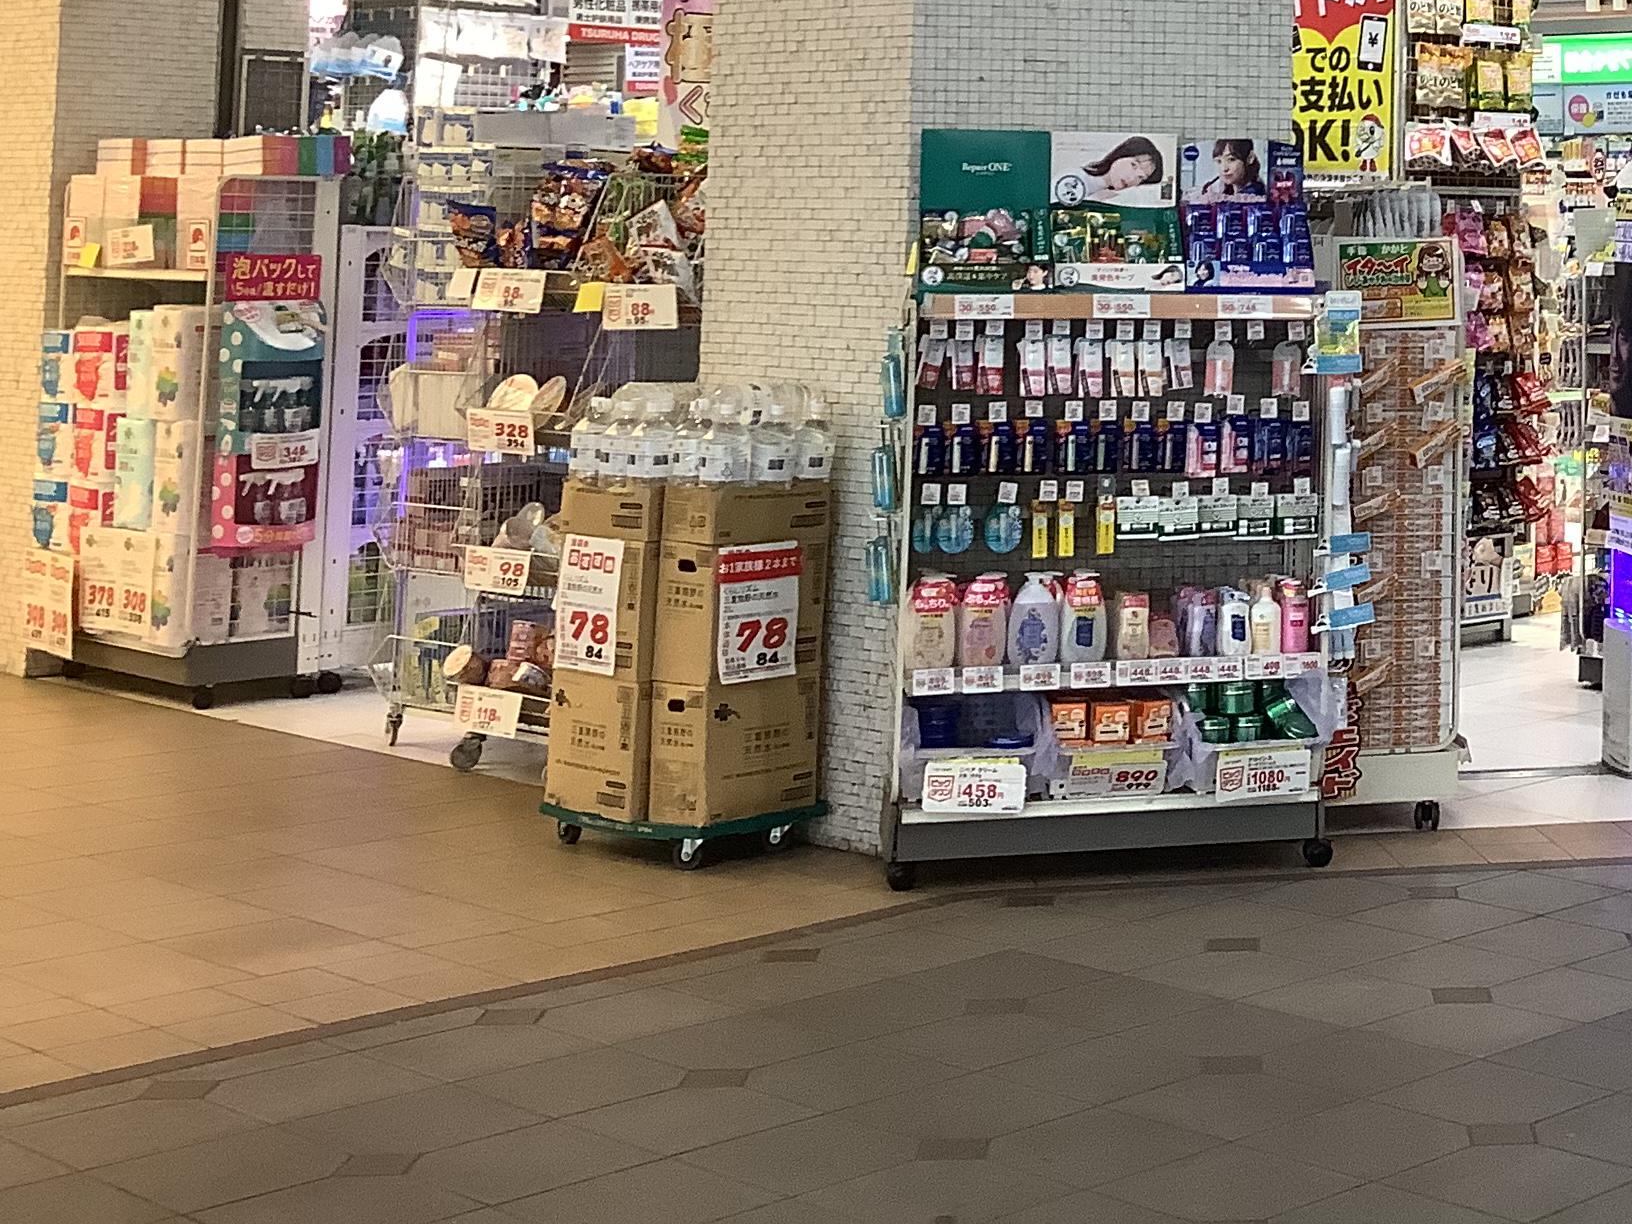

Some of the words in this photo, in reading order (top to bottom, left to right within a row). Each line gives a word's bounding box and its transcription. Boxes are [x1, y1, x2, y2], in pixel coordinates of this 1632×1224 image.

[1305, 45, 1351, 73] での
[232, 256, 317, 279] 泡パックして
[494, 422, 529, 439] 328
[499, 561, 526, 577] 98
[569, 610, 609, 645] 78
[736, 617, 789, 653] 78
[585, 645, 603, 659] 84
[756, 651, 780, 666] 84
[1115, 769, 1159, 783] 890
[1251, 769, 1286, 785] 1080
[962, 784, 998, 799] 458
[967, 798, 990, 808] 503
